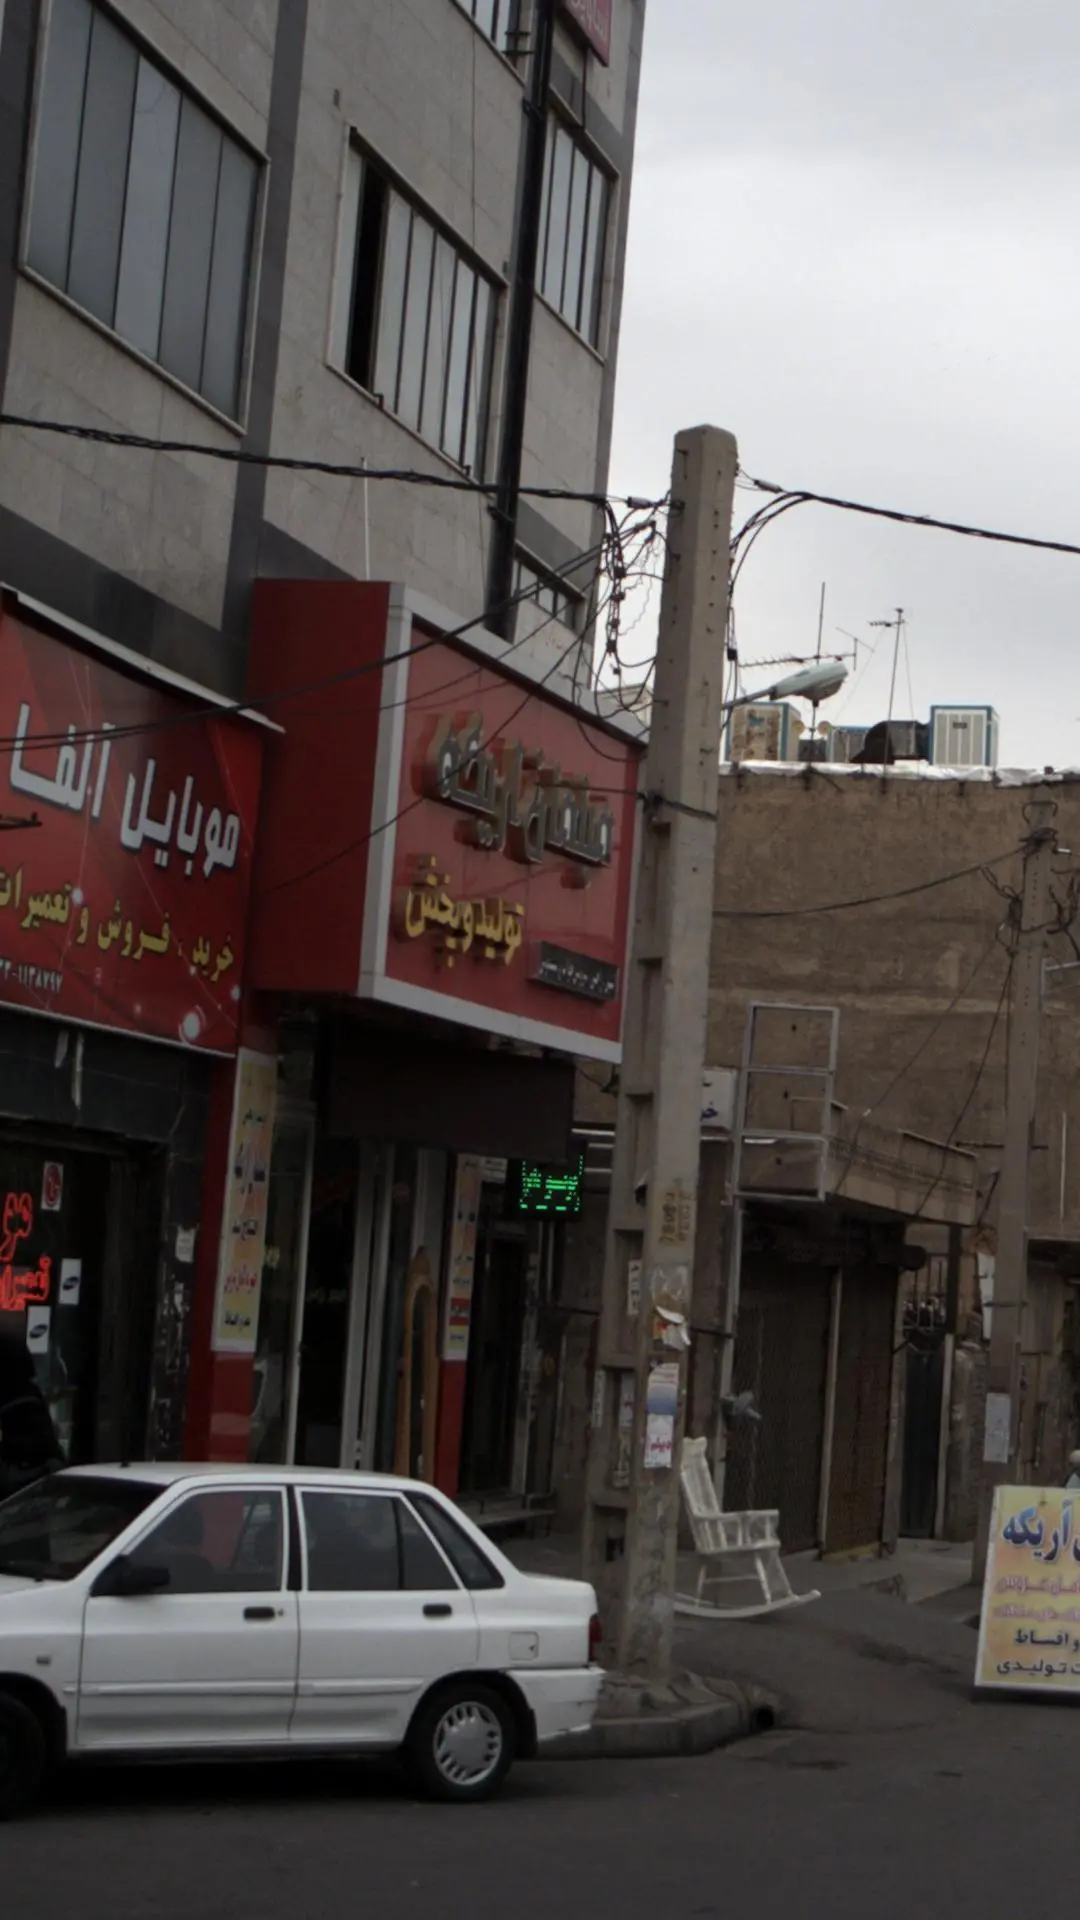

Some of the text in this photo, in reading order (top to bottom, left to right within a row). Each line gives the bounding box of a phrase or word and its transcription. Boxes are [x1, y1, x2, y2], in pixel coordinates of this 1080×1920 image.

[120, 757, 240, 878] موبایل
[0, 867, 73, 931] تعمیرات
[76, 904, 89, 947] و
[405, 856, 458, 969] پخش
[97, 902, 171, 961] فروش
[190, 934, 234, 983] خرید
[474, 896, 523, 967] تولید
[1014, 1628, 1069, 1647] اقساط
[996, 1659, 1067, 1678] تولیدی
